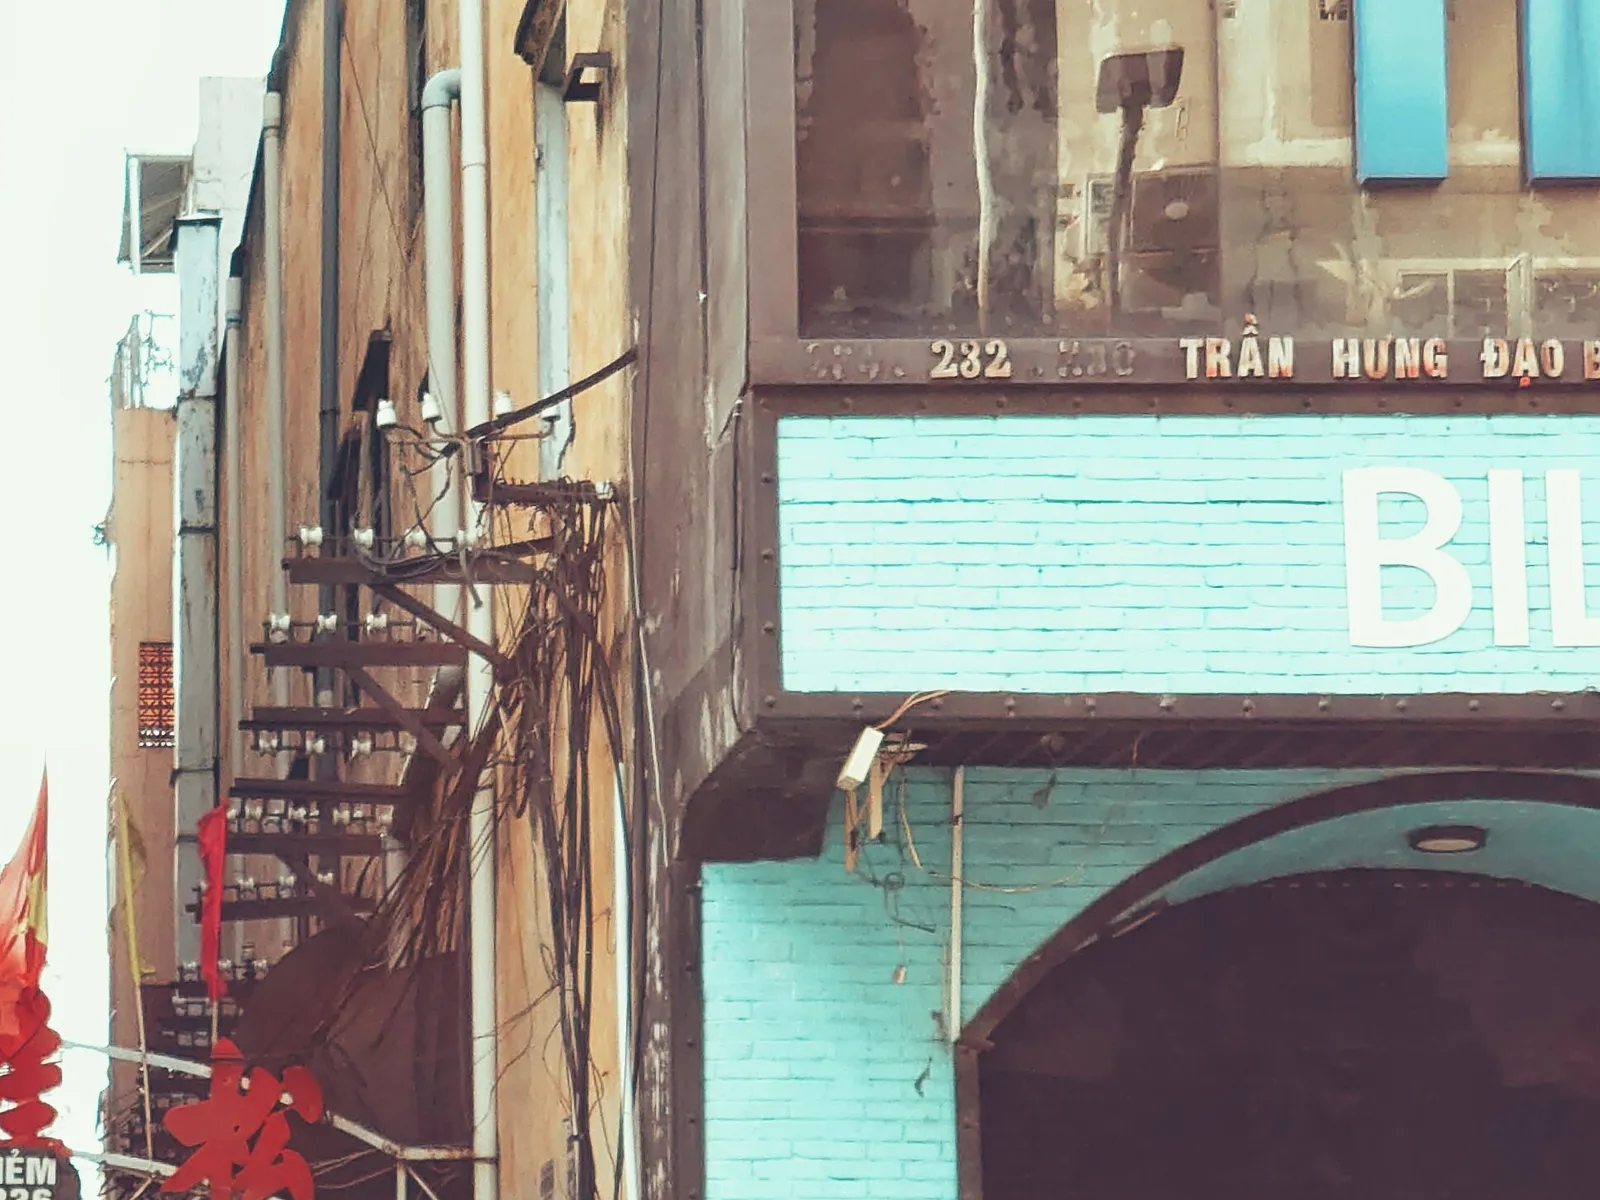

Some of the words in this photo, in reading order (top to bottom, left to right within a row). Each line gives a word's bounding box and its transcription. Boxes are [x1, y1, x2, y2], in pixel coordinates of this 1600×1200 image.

[930, 339, 1012, 379] 232
[1179, 312, 1295, 379] TRẦN
[1332, 333, 1449, 379] HƯNG
[1479, 336, 1565, 388] ĐẠO
[1342, 466, 1600, 648] BIL
